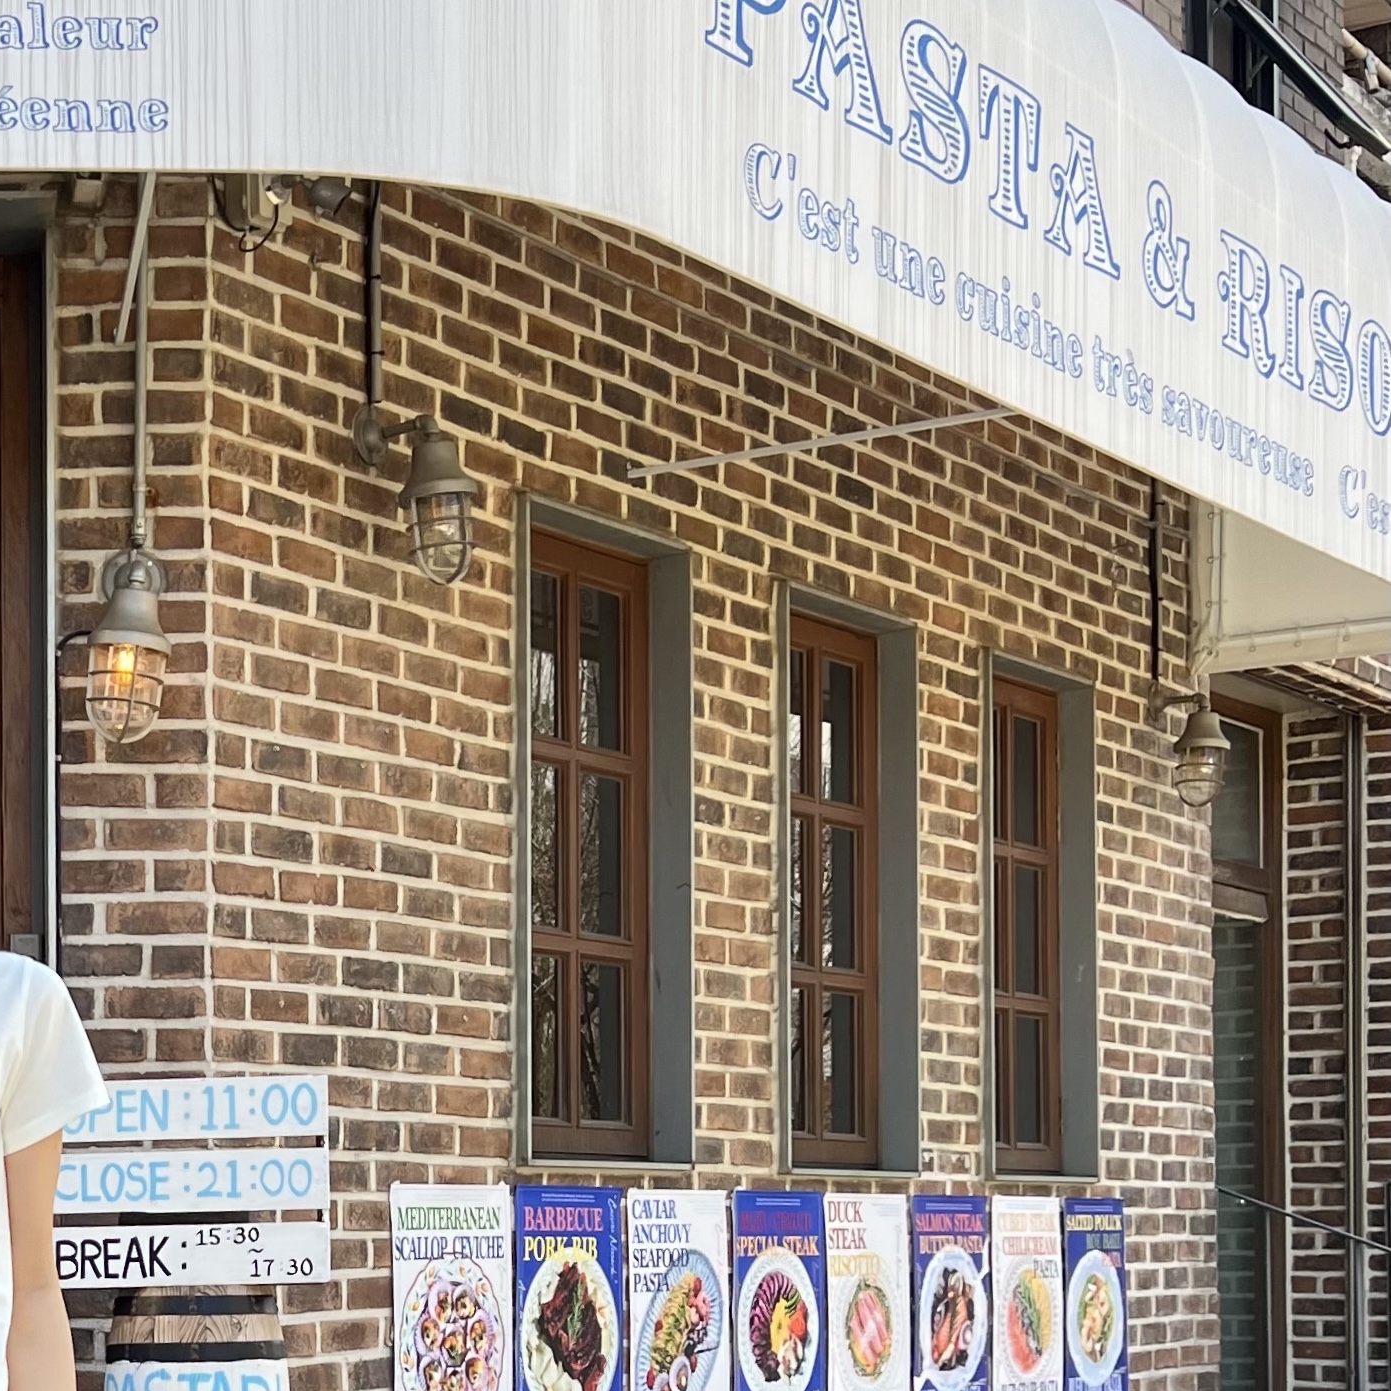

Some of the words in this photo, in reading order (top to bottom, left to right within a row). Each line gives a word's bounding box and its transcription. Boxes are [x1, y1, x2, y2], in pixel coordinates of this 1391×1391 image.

[1142, 180, 1196, 321] &
[744, 142, 860, 265] C'est
[871, 226, 946, 305] une
[956, 271, 1084, 380] cuisine
[1091, 335, 1154, 415] très
[1161, 383, 1315, 497] savoureuse
[56, 1160, 170, 1201] CLOSE
[397, 1206, 501, 1231] MEDITERRANEAN
[523, 1205, 604, 1232] BARBECUE
[631, 1199, 677, 1219] CAVIAR
[827, 1200, 863, 1223] DUCK
[631, 1223, 692, 1244] ANCHOVY
[915, 1213, 953, 1232] SALMON
[953, 1213, 985, 1232] STEAK
[195, 1227, 260, 1246] 15:30
[394, 1235, 448, 1261] SCALLOP
[452, 1235, 505, 1260] CEVICHE
[783, 1235, 820, 1256] STEAK
[828, 1227, 867, 1250] STEAK
[522, 1235, 569, 1262] PORK
[632, 1247, 690, 1269] SEAFOOD
[829, 1254, 881, 1277] RISOTTO
[1033, 1259, 1060, 1279] PASTA
[633, 1272, 670, 1293] PASTA
